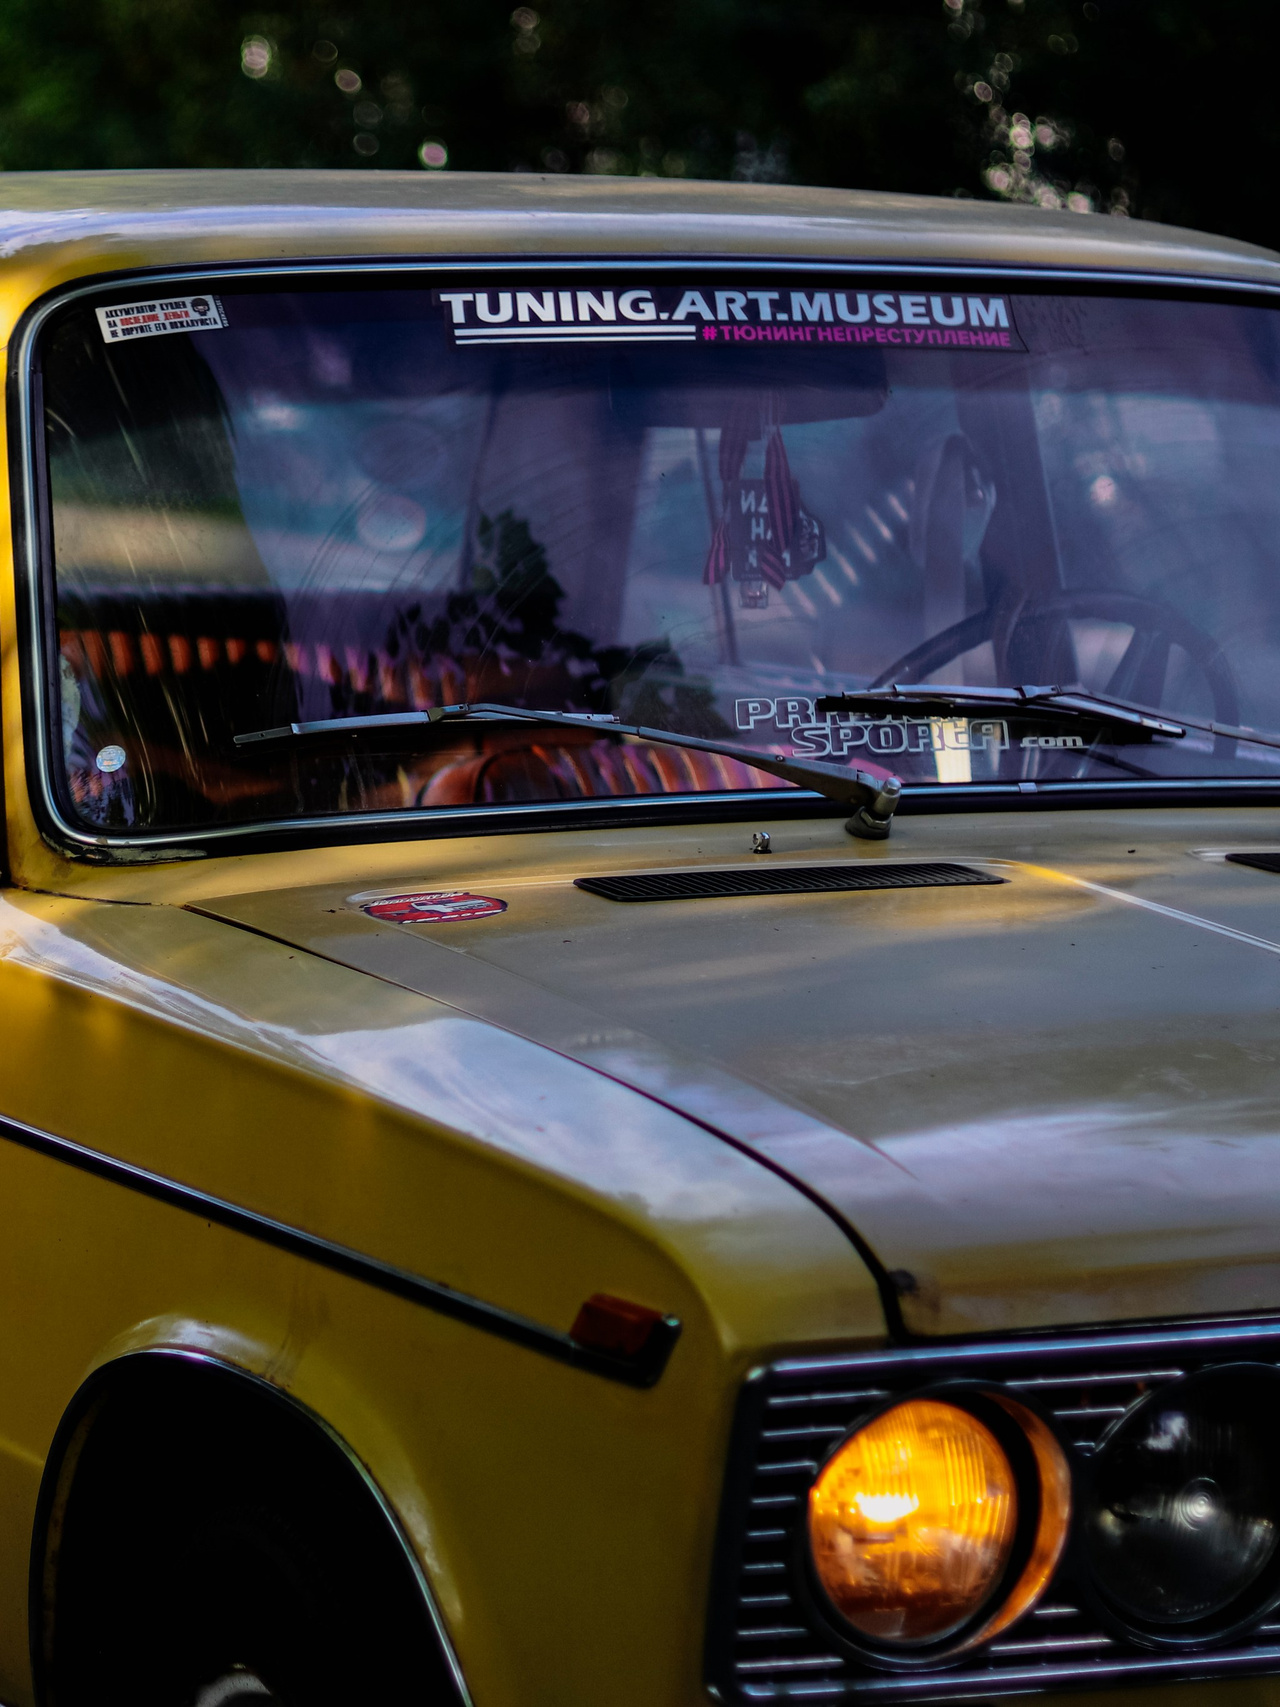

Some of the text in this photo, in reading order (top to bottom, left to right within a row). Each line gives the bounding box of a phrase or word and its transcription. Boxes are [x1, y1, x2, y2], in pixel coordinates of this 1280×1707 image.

[105, 300, 188, 319] АККУМУЛЯТОР КУПЛЕН
[440, 289, 1010, 327] TUNING.ART.MUSEUM
[107, 310, 191, 329] НА ПОСЛЕДНИЕ ДЕНЬГИ
[110, 317, 219, 338] НЕ ВОРУЙТЕ ЕГО ПОЖАЛУЙСТА
[702, 324, 1011, 347] #ТЮНИНГНЕПРЕСТУПЛЕНИЕ
